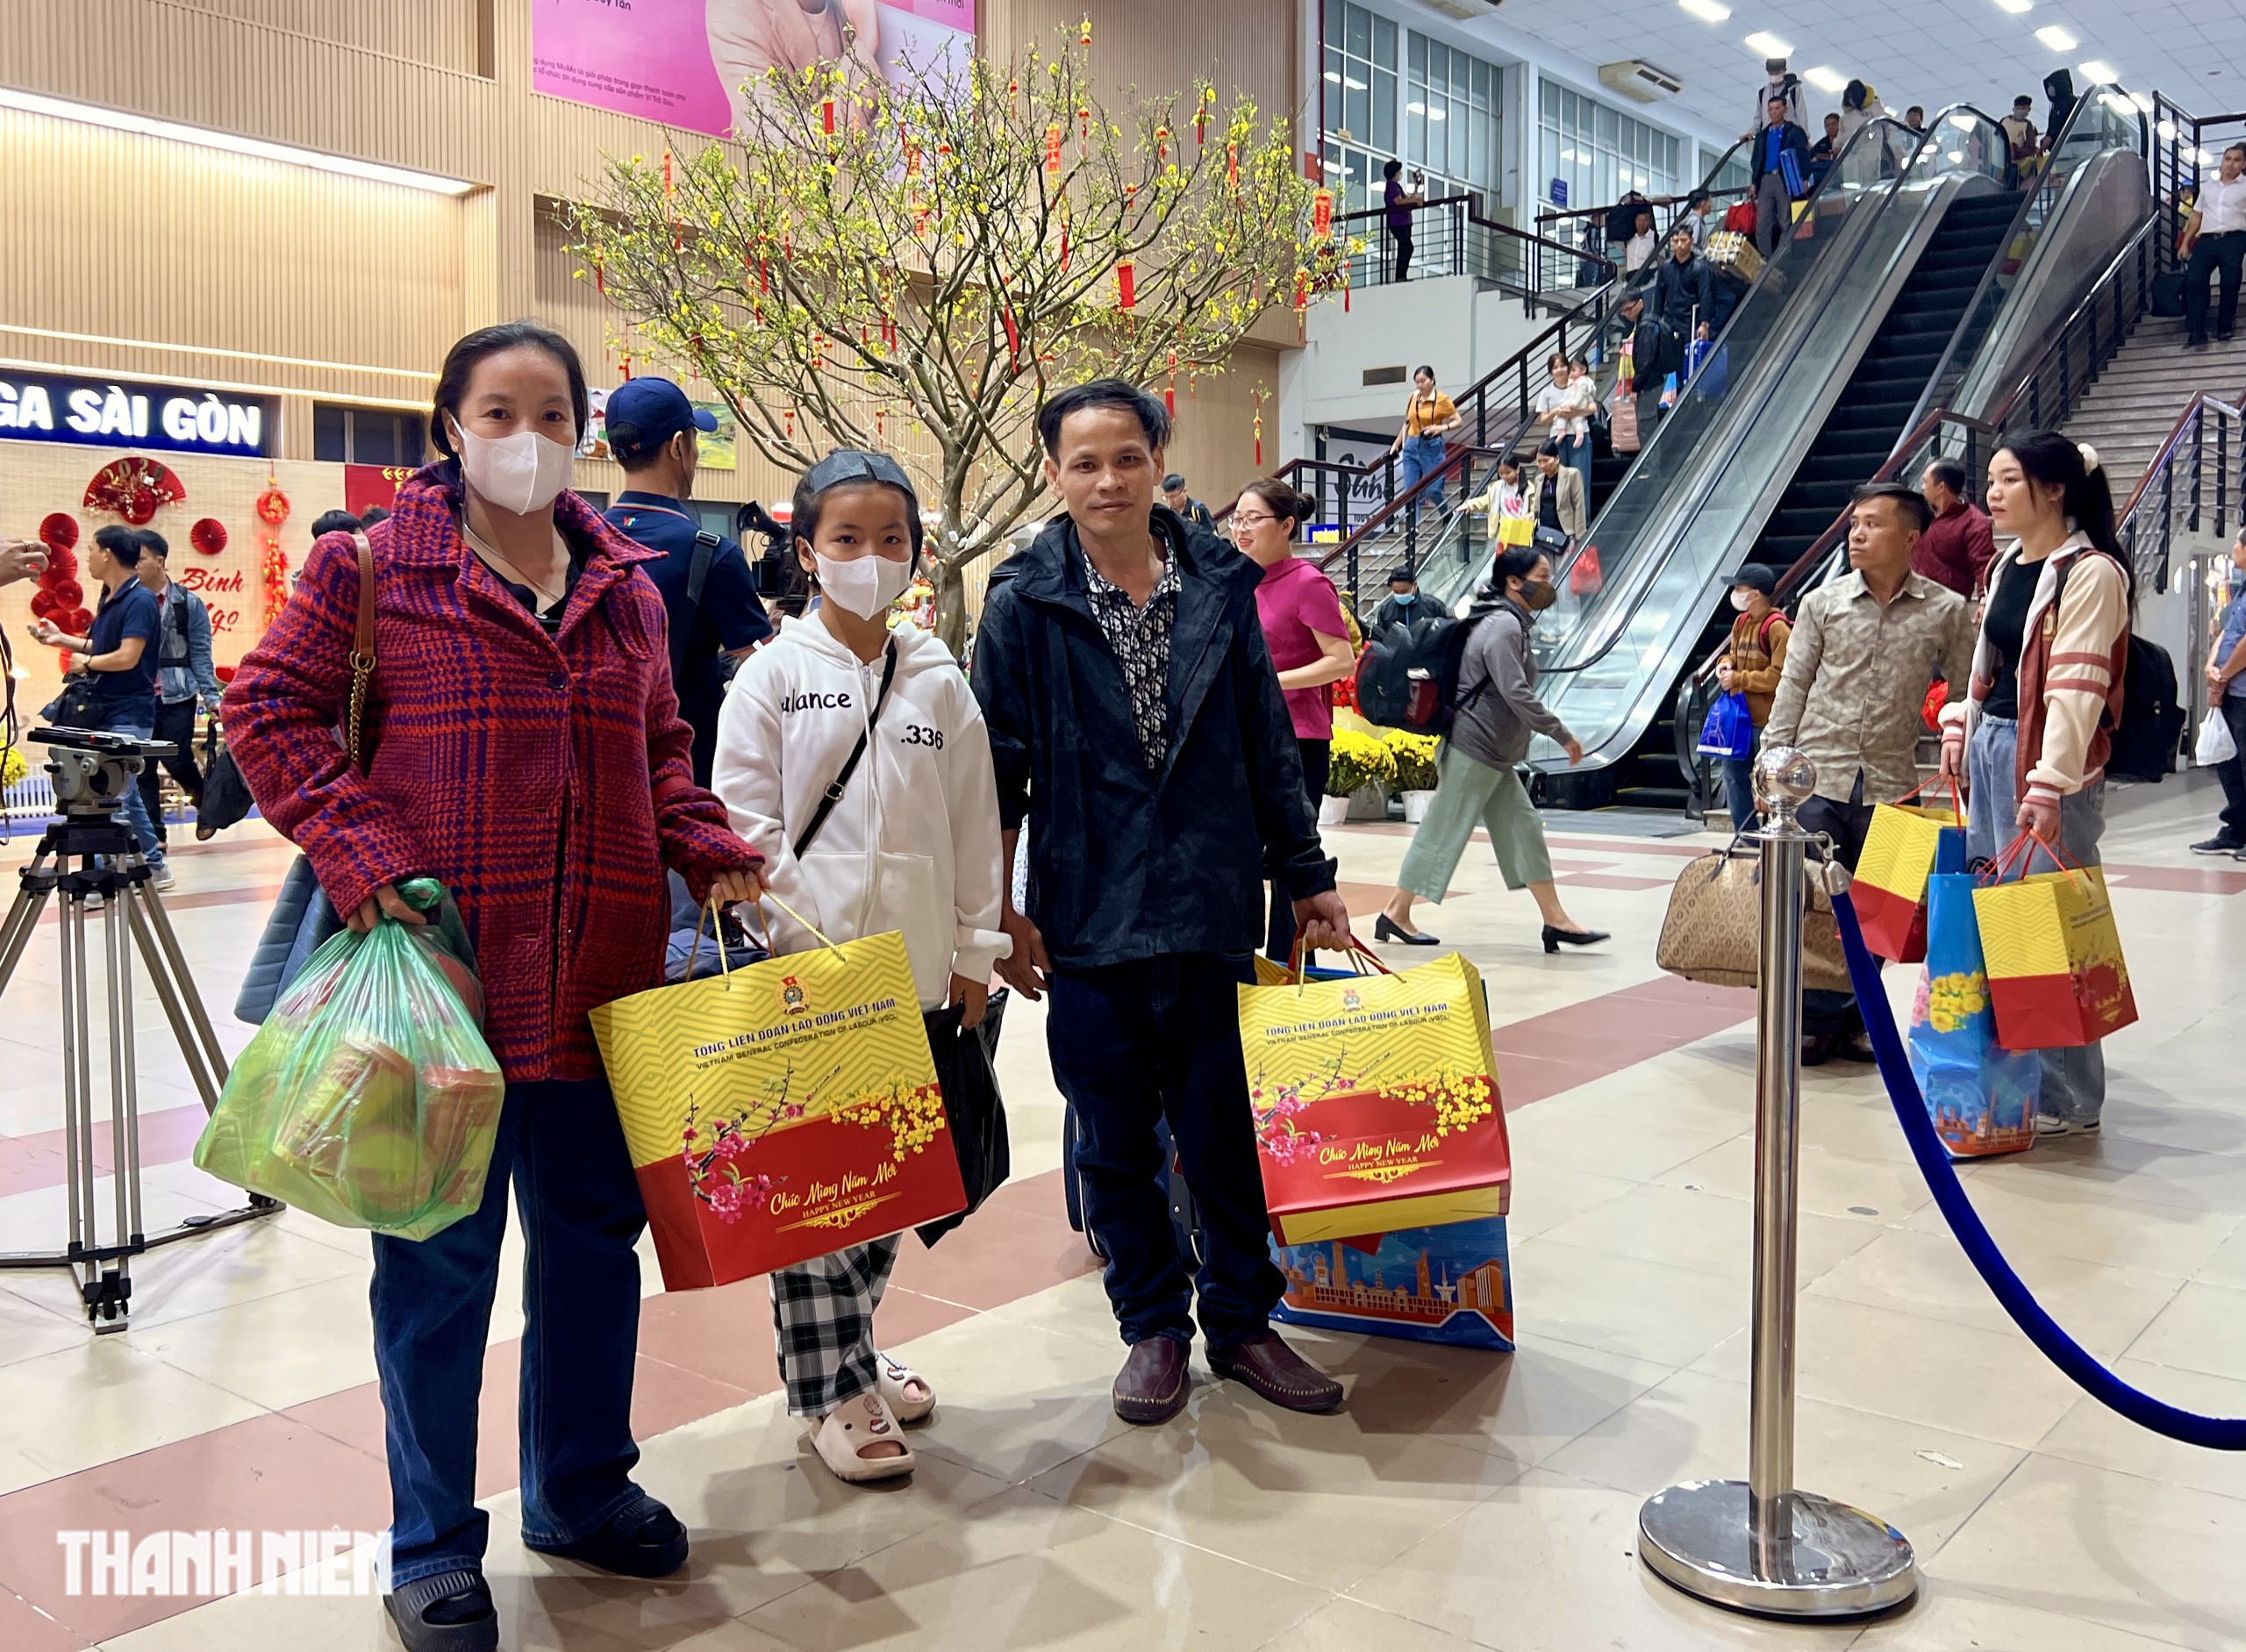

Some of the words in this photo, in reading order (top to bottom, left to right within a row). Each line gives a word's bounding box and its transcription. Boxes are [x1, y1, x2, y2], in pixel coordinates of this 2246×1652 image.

[66, 385, 148, 437] SÀI
[162, 393, 261, 446] GÒN
[178, 567, 244, 593] Bính
[206, 603, 240, 636] gọ
[792, 1019, 812, 1032] LAO
[872, 998, 896, 1012] NAM
[1348, 1015, 1367, 1025] LAO
[1424, 1003, 1448, 1014] NAM
[696, 1054, 734, 1070] VIETNAM
[736, 1045, 773, 1060] GENERAL
[774, 1028, 835, 1049] CONFEDERATION
[849, 1018, 876, 1031] LABOUR
[1266, 1036, 1297, 1046] VIETNAM
[1298, 1032, 1329, 1041] GENERAL
[1331, 1023, 1387, 1036] CONFEDERATION
[1400, 1017, 1427, 1026] LABOUR
[1348, 1160, 1375, 1171] HAPPY
[1376, 1158, 1395, 1167] NEW
[1396, 1155, 1419, 1164] YEAR
[770, 1191, 801, 1215] Chúc
[841, 1169, 868, 1196] Năm
[802, 1203, 831, 1219] HAPPY
[832, 1198, 852, 1210] NEW
[852, 1190, 876, 1204] YEAR
